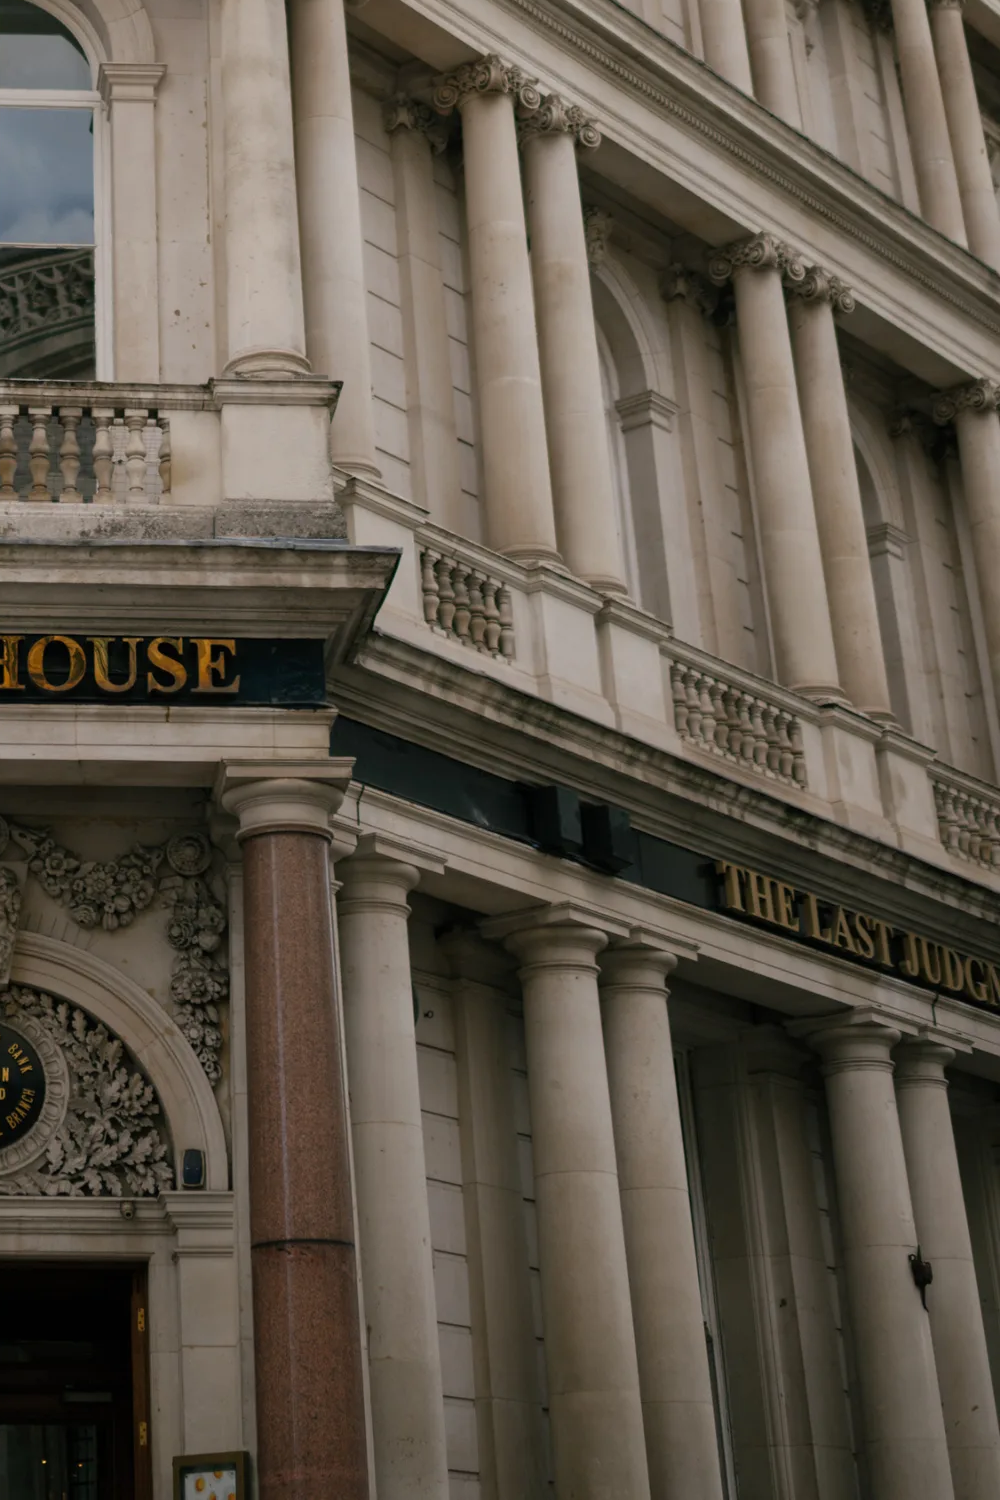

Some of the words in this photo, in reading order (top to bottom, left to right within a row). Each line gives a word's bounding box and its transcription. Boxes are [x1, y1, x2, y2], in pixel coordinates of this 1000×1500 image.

[714, 859, 799, 932] THE
[803, 891, 895, 968] LAST
[7, 1043, 34, 1074] BANK
[5, 1088, 36, 1130] BRANCH
